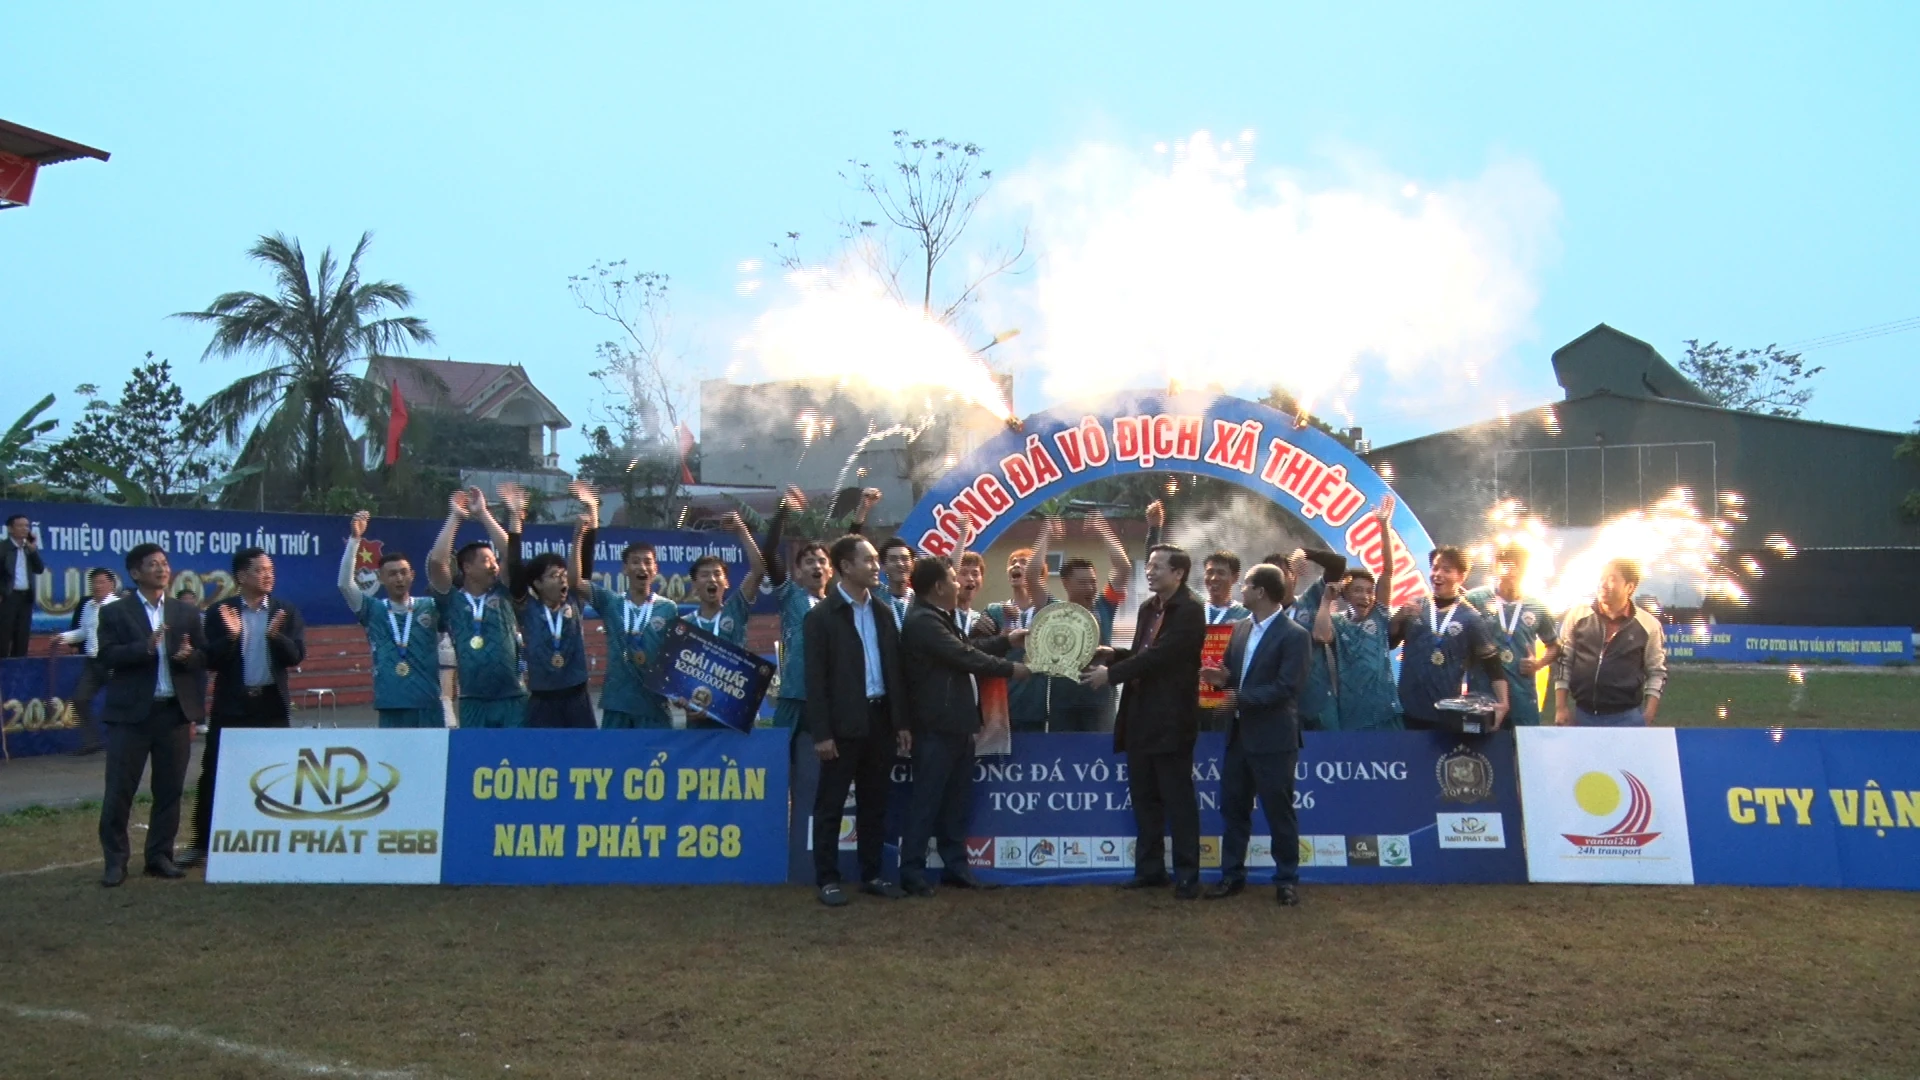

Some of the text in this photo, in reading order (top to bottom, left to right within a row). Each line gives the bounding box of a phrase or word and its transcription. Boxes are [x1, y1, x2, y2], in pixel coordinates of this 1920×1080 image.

[919, 475, 1012, 556] BÓNG
[1001, 436, 1061, 497] ĐÁ
[1055, 417, 1108, 471] VÔ
[1114, 416, 1202, 466] ĐỊCH
[1206, 421, 1262, 473] XÃ
[1262, 438, 1366, 525] THIỆU
[49, 523, 104, 556] THIỆU
[110, 529, 170, 554] QUANG
[175, 531, 204, 555] TQF
[209, 532, 242, 554] CUP
[280, 530, 310, 555] THỨ
[312, 535, 319, 555] 1
[594, 541, 607, 560] XÃ
[680, 649, 710, 671] GIẢI
[473, 752, 766, 801] CÔNG TY CỔ PHẦN
[973, 758, 1023, 782] ÓNG
[1030, 757, 1066, 782] ĐÁ
[1072, 758, 1110, 782] VÔ
[1191, 758, 1221, 781] XÃ
[1316, 761, 1408, 784] QUANG
[989, 792, 1041, 815] TQF
[1047, 792, 1099, 811] CUP
[1292, 790, 1316, 809] 26
[1727, 780, 1920, 837] CTY VẬN
[212, 825, 438, 854] NAM PHÁT 268
[493, 817, 742, 858] NAM PHÁT 268
[1578, 847, 1642, 856] 24h transport
